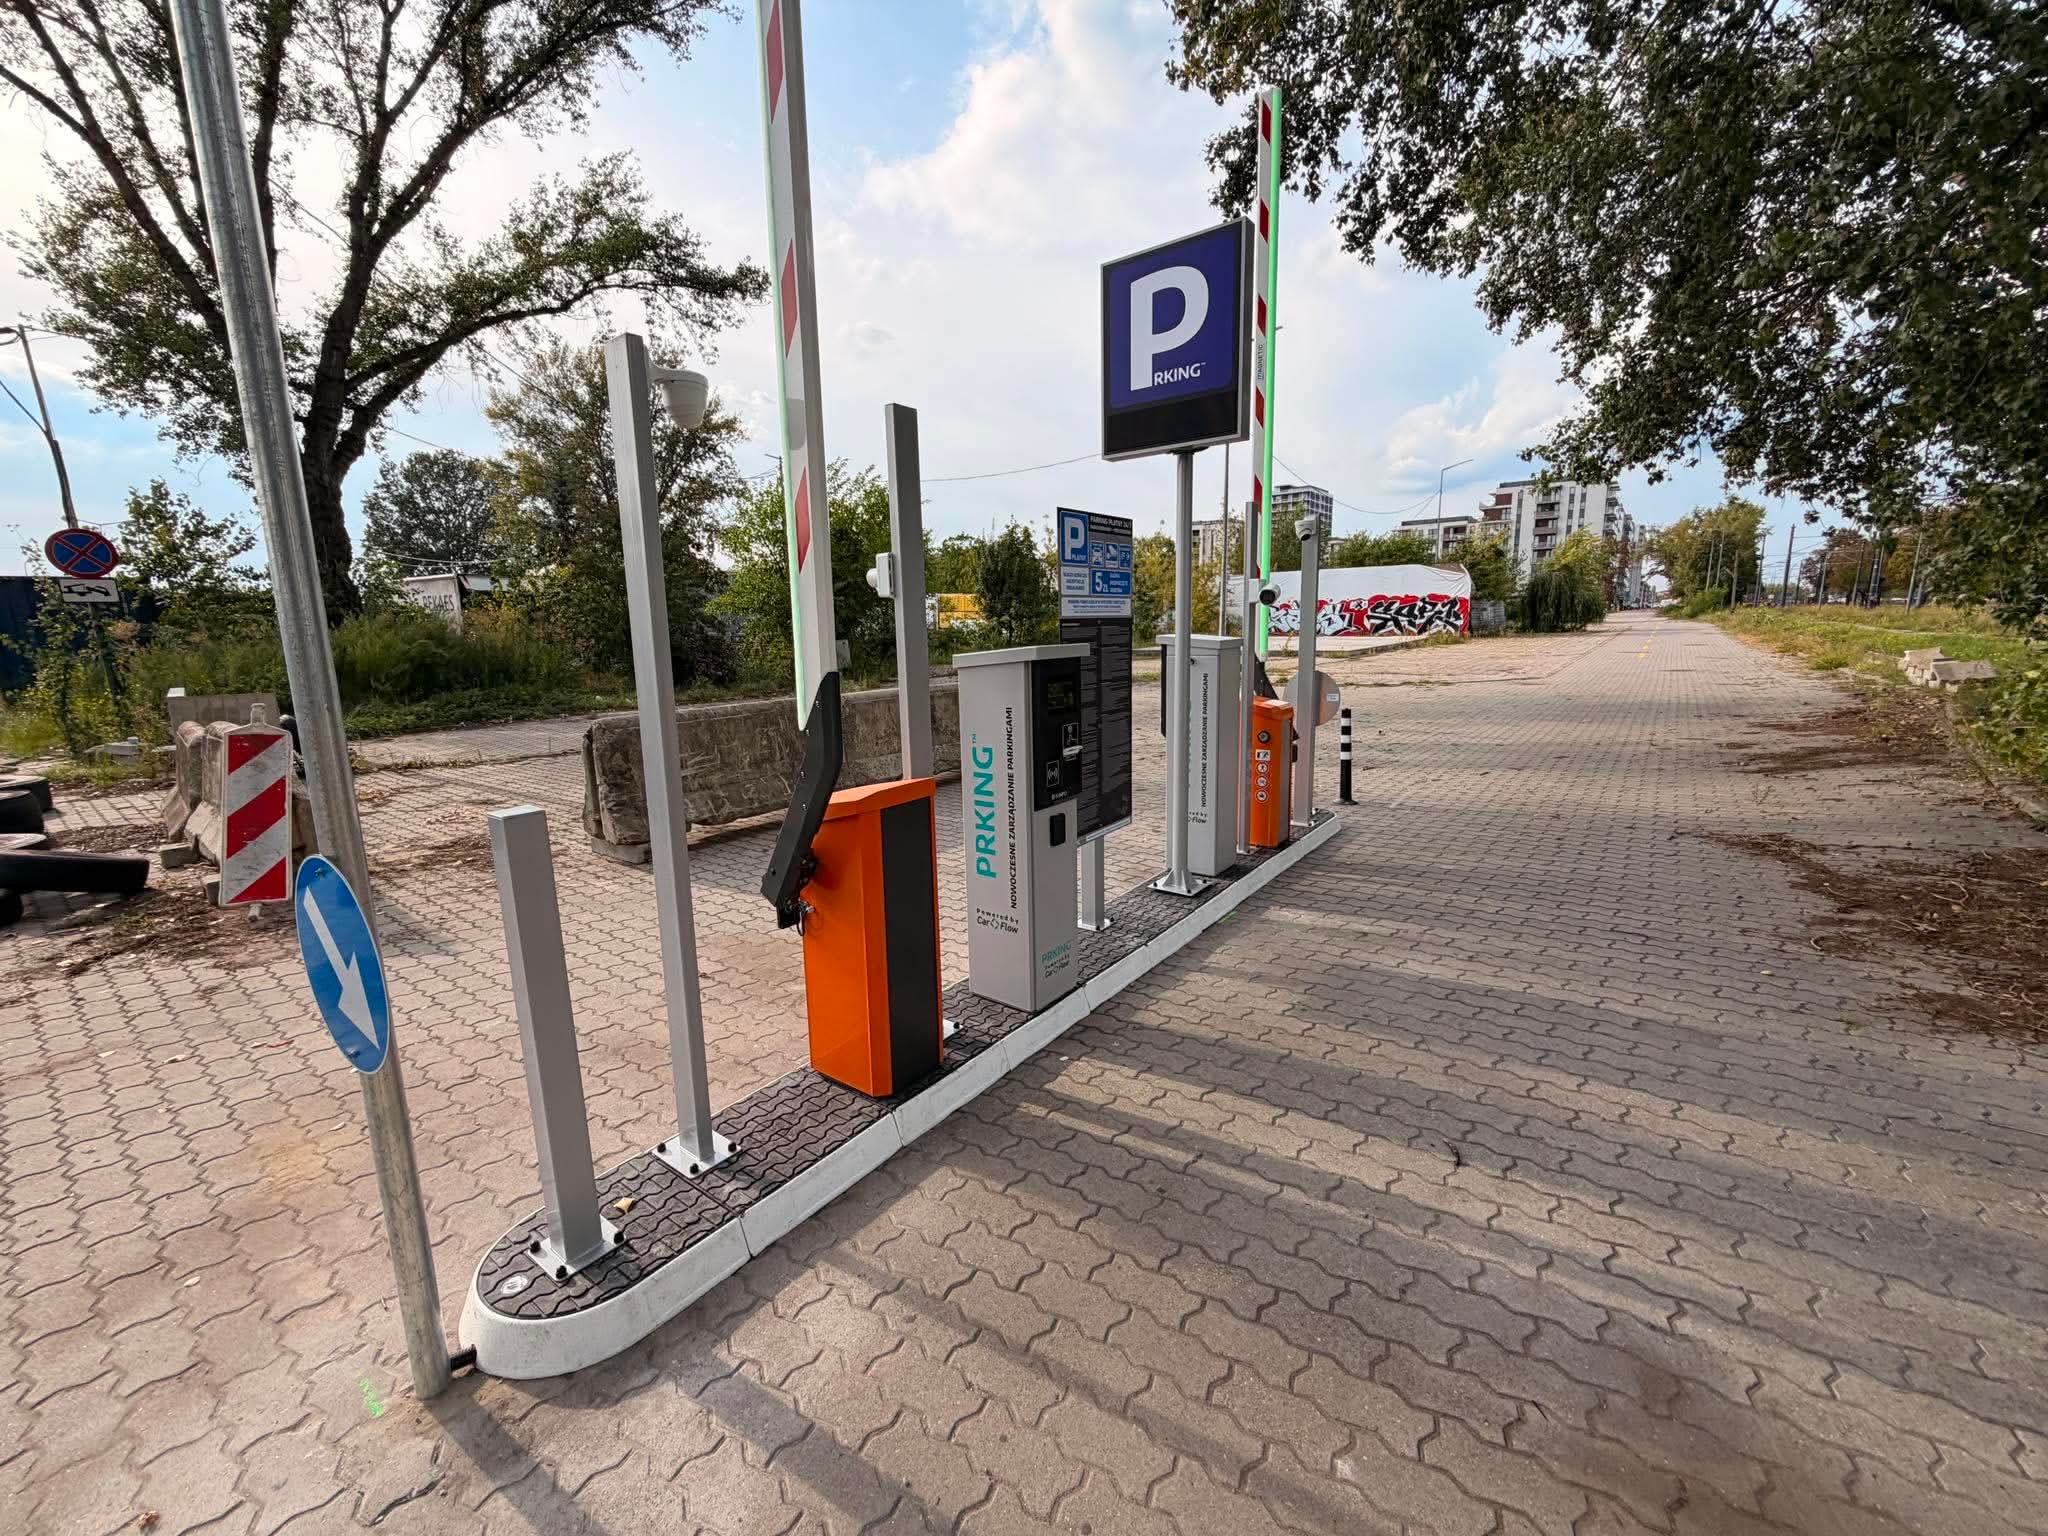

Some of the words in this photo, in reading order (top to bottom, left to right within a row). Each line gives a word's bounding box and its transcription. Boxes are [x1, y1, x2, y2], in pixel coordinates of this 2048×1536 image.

[1064, 516, 1085, 560] P
[1095, 572, 1103, 593] 5
[1005, 707, 1014, 770] PARKINGAMI
[1007, 773, 1017, 840] ZARZĄDZANIE
[1008, 842, 1018, 909] NOWOCZESNE
